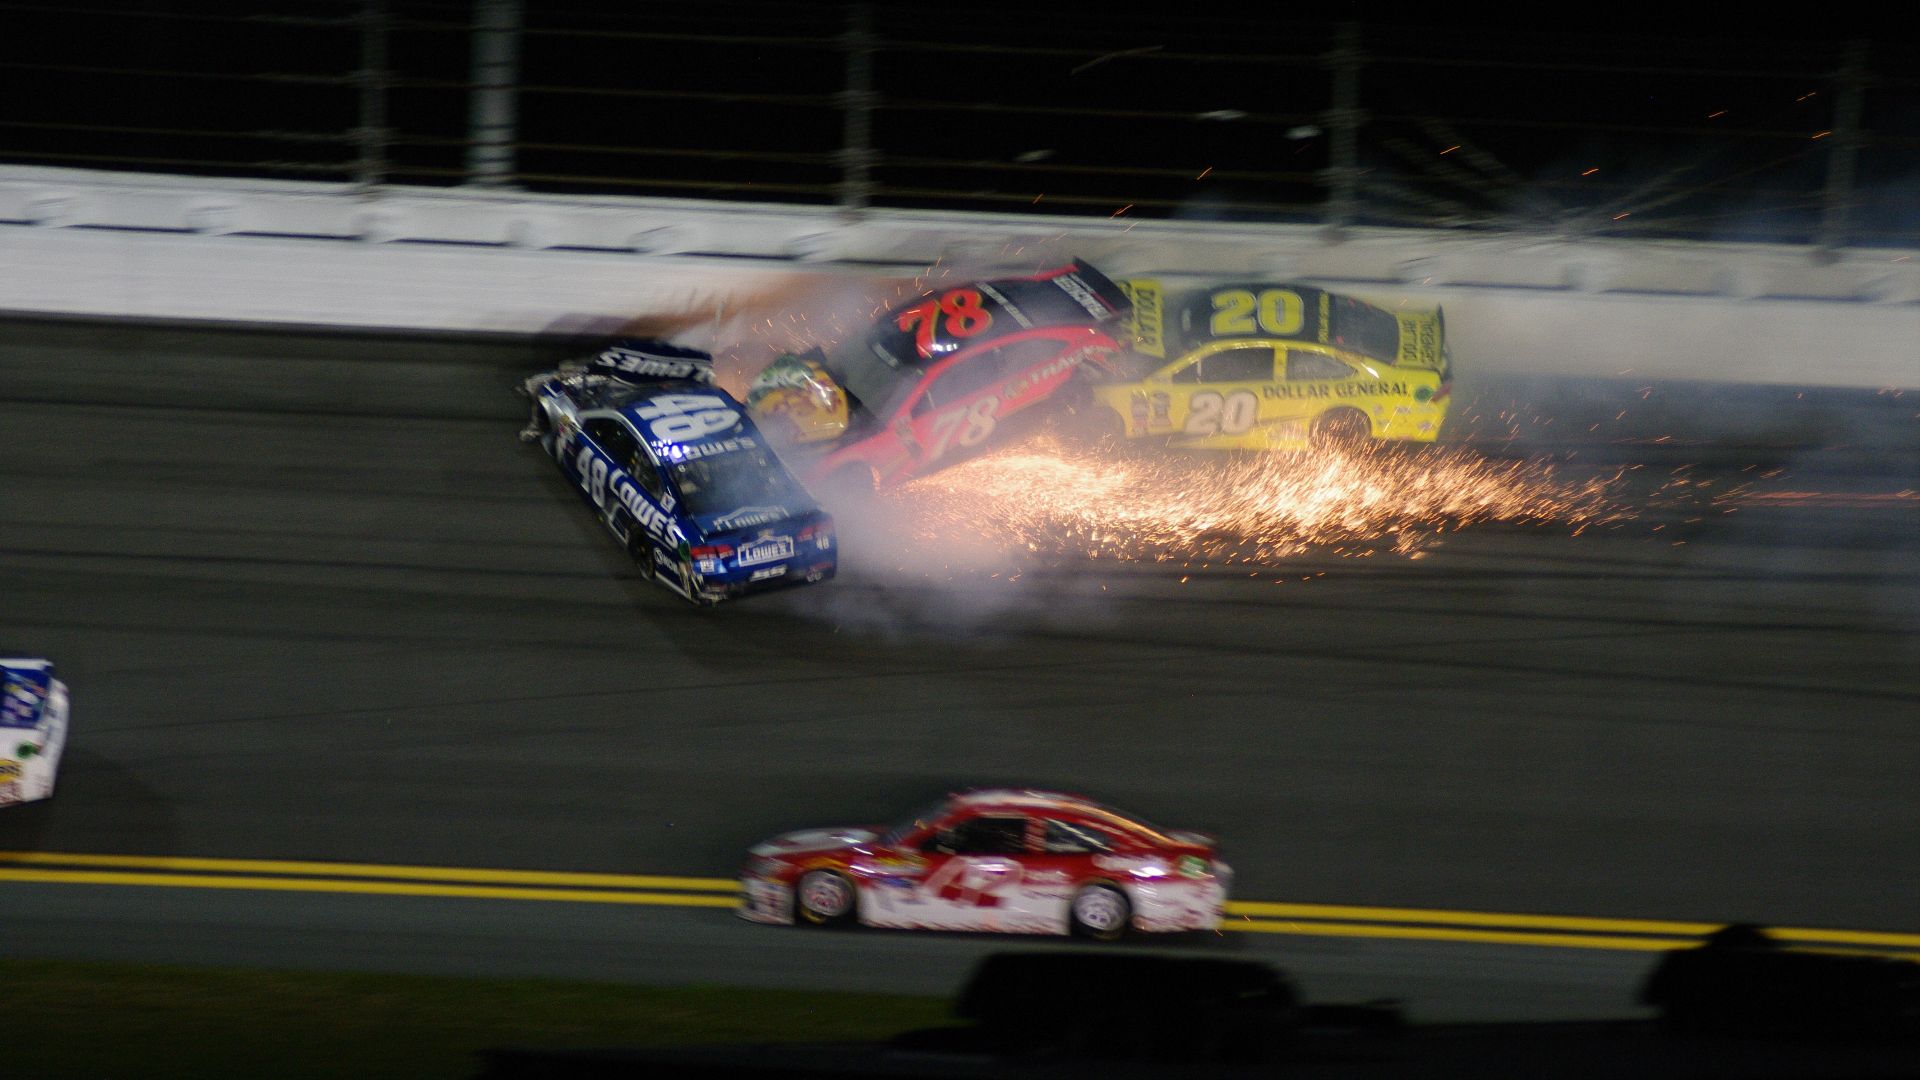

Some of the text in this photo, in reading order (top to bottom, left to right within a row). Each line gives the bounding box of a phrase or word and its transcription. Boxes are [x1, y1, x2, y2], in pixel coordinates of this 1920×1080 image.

[897, 288, 993, 358] 78
[1209, 288, 1304, 336] 20
[1185, 389, 1259, 434] 20
[1262, 383, 1409, 399] DOLLAR GENERAL
[634, 394, 741, 442] 48
[930, 395, 999, 461] 78
[577, 446, 608, 508] 48
[609, 468, 680, 549] LOWE'S
[816, 535, 829, 550] 48
